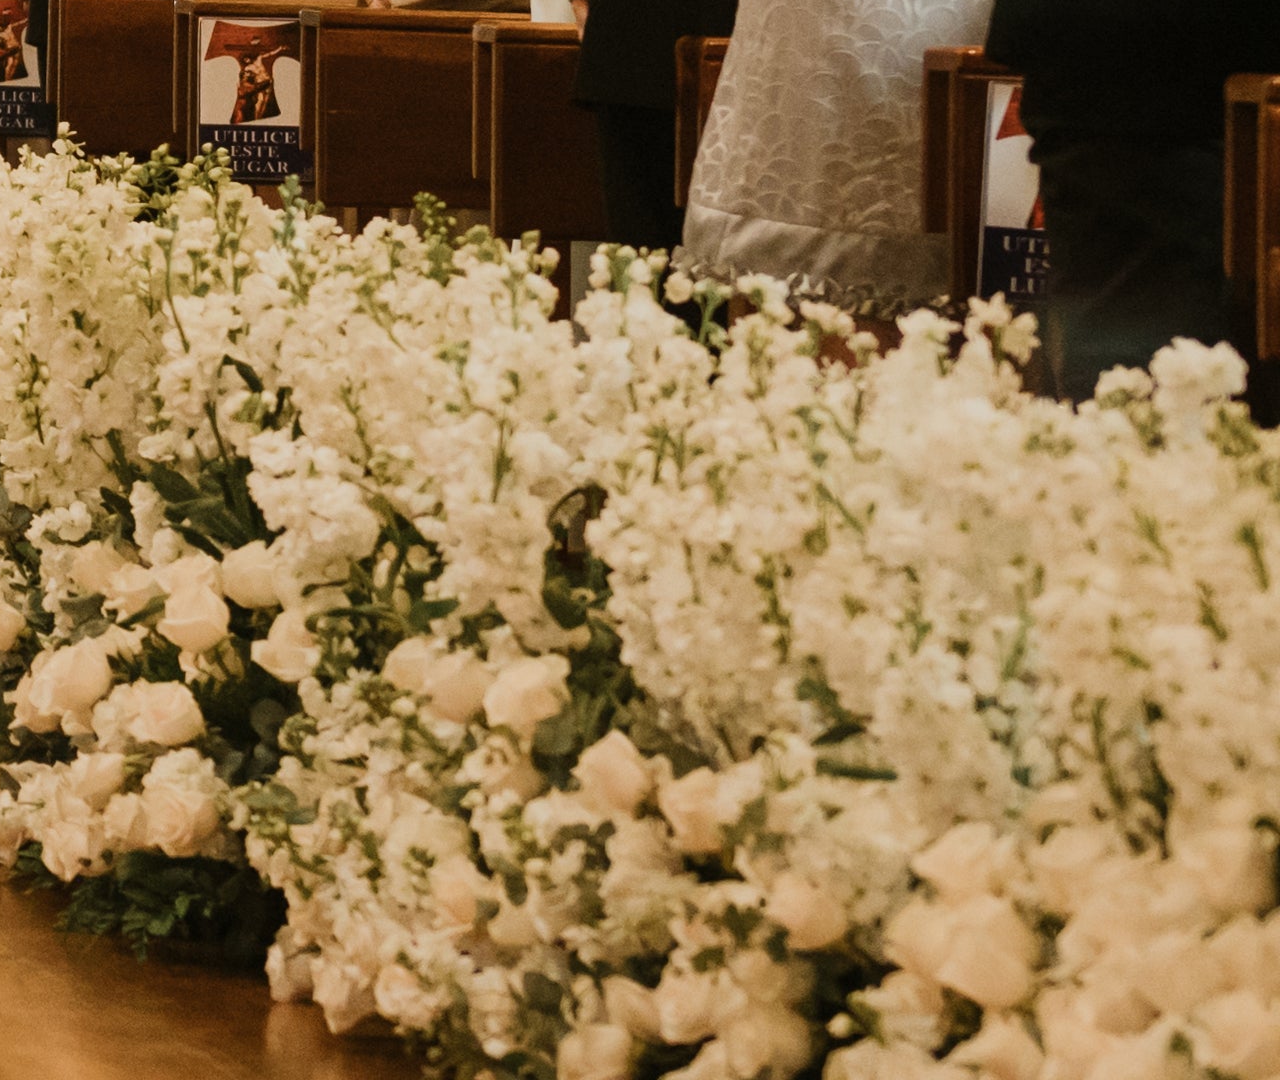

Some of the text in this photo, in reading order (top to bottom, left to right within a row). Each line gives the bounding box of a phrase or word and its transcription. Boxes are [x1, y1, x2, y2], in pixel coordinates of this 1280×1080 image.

[214, 130, 297, 144] UTILICE
[231, 145, 280, 158] ESTE
[233, 160, 289, 173] UGAR
